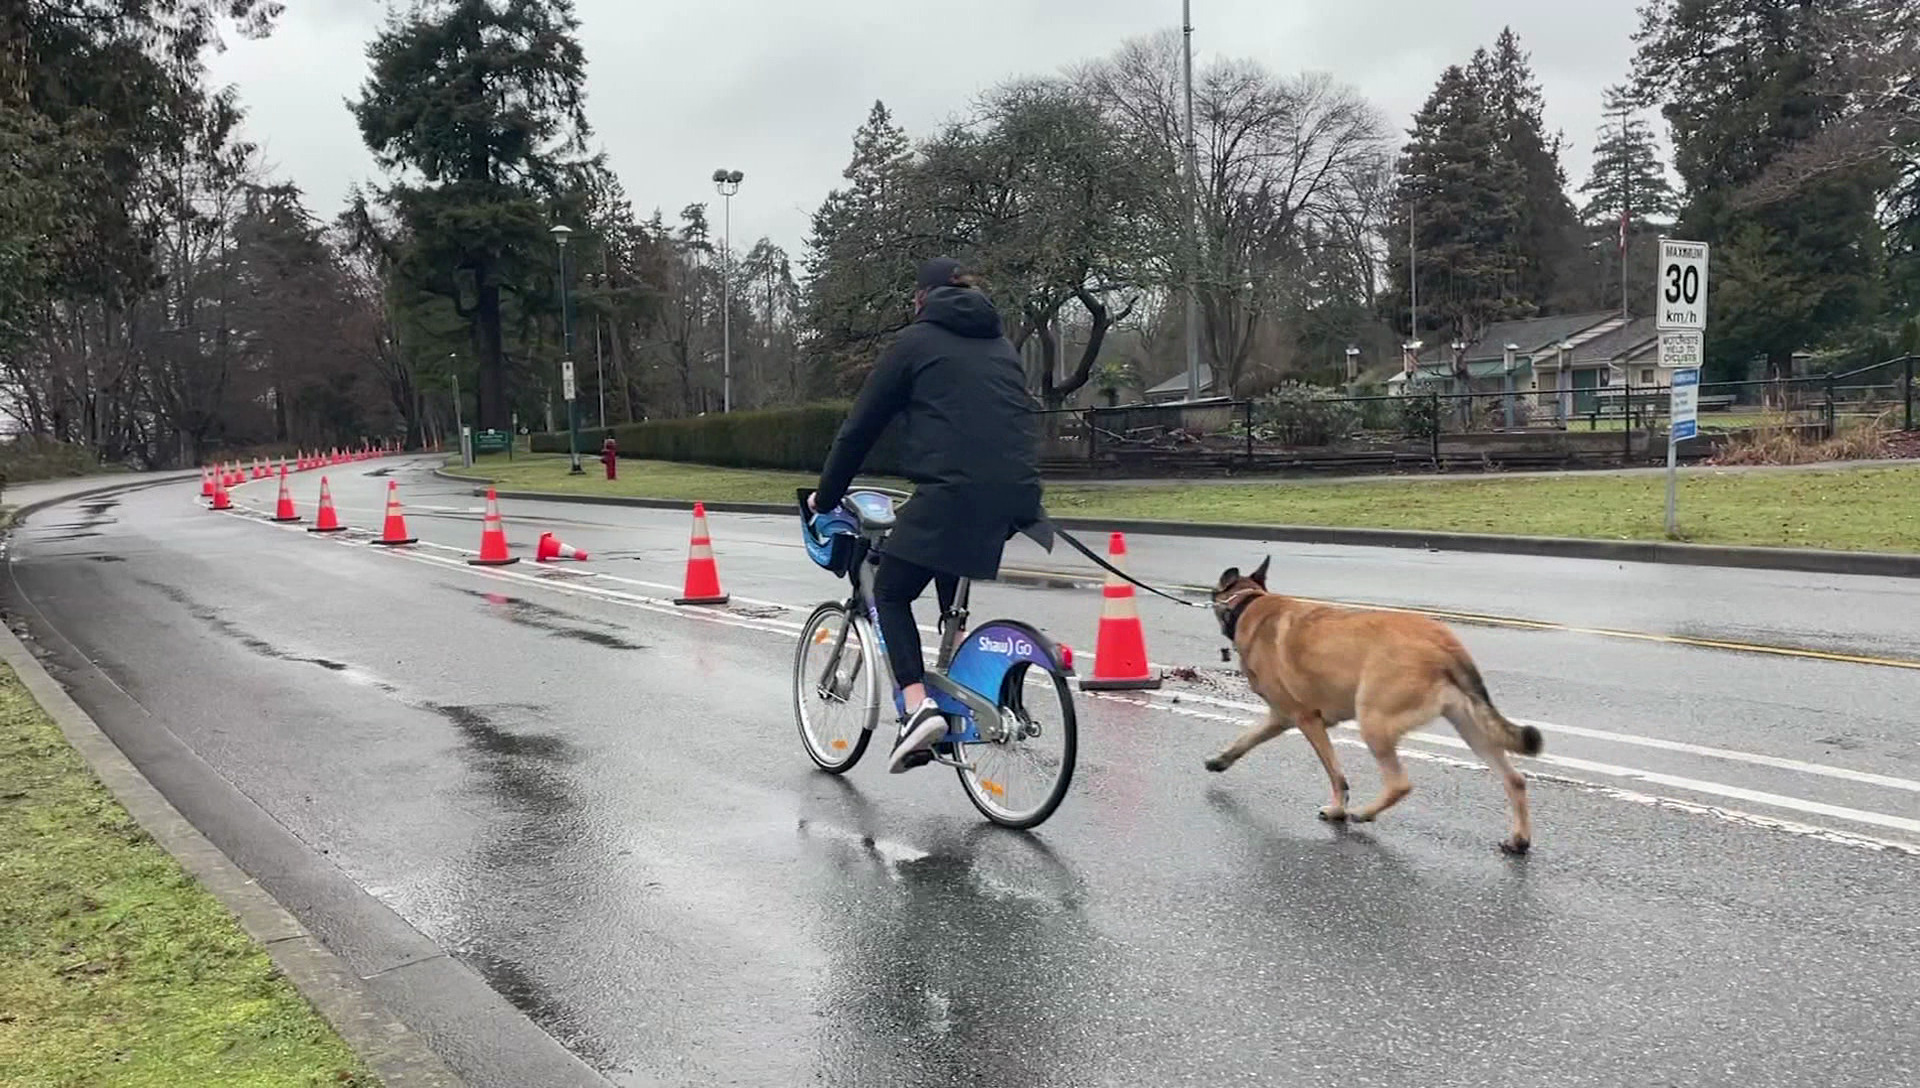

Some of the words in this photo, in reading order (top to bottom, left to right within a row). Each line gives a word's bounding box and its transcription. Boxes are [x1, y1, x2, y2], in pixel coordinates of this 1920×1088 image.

[1665, 245, 1703, 259] MAXIMUM
[1665, 264, 1698, 305] 30
[1666, 310, 1697, 324] km/h
[1664, 345, 1685, 354] YIELD
[1686, 345, 1696, 353] TO
[1015, 639, 1033, 656] Go
